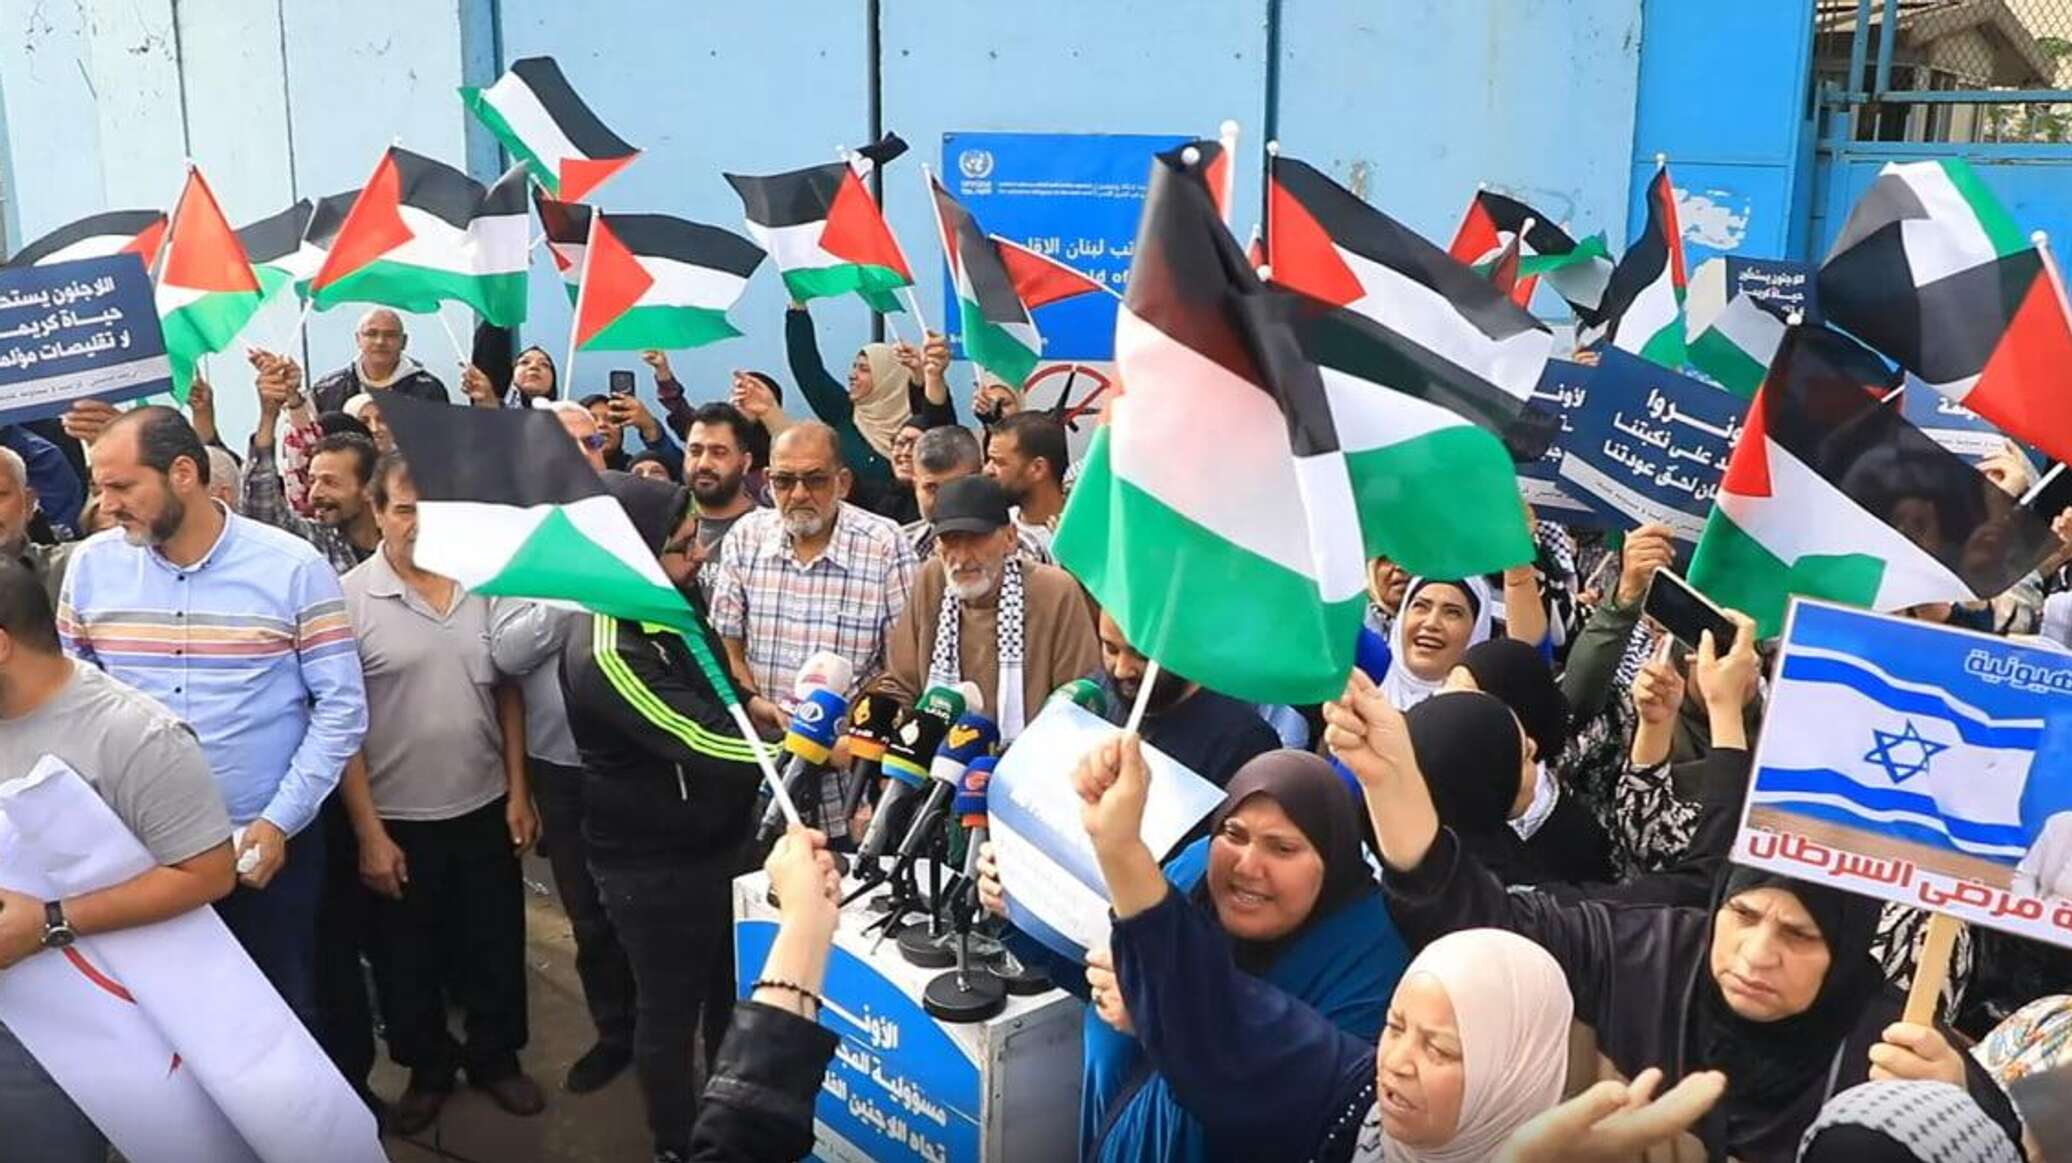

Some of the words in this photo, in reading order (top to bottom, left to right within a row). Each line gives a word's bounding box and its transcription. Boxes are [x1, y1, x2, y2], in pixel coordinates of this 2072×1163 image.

[1066, 238, 1104, 259] لبنان
[0, 313, 61, 340] كريم
[62, 307, 123, 327] حياة
[39, 331, 116, 358] تقليصات
[119, 329, 131, 348] لا
[0, 347, 38, 369] مؤلم
[1646, 388, 1743, 448] ونروا
[1603, 439, 1657, 477] عودتنا
[1668, 444, 1713, 466] على
[1749, 825, 1915, 888] السرطان
[818, 995, 899, 1049] الأون
[835, 1043, 870, 1076] المج
